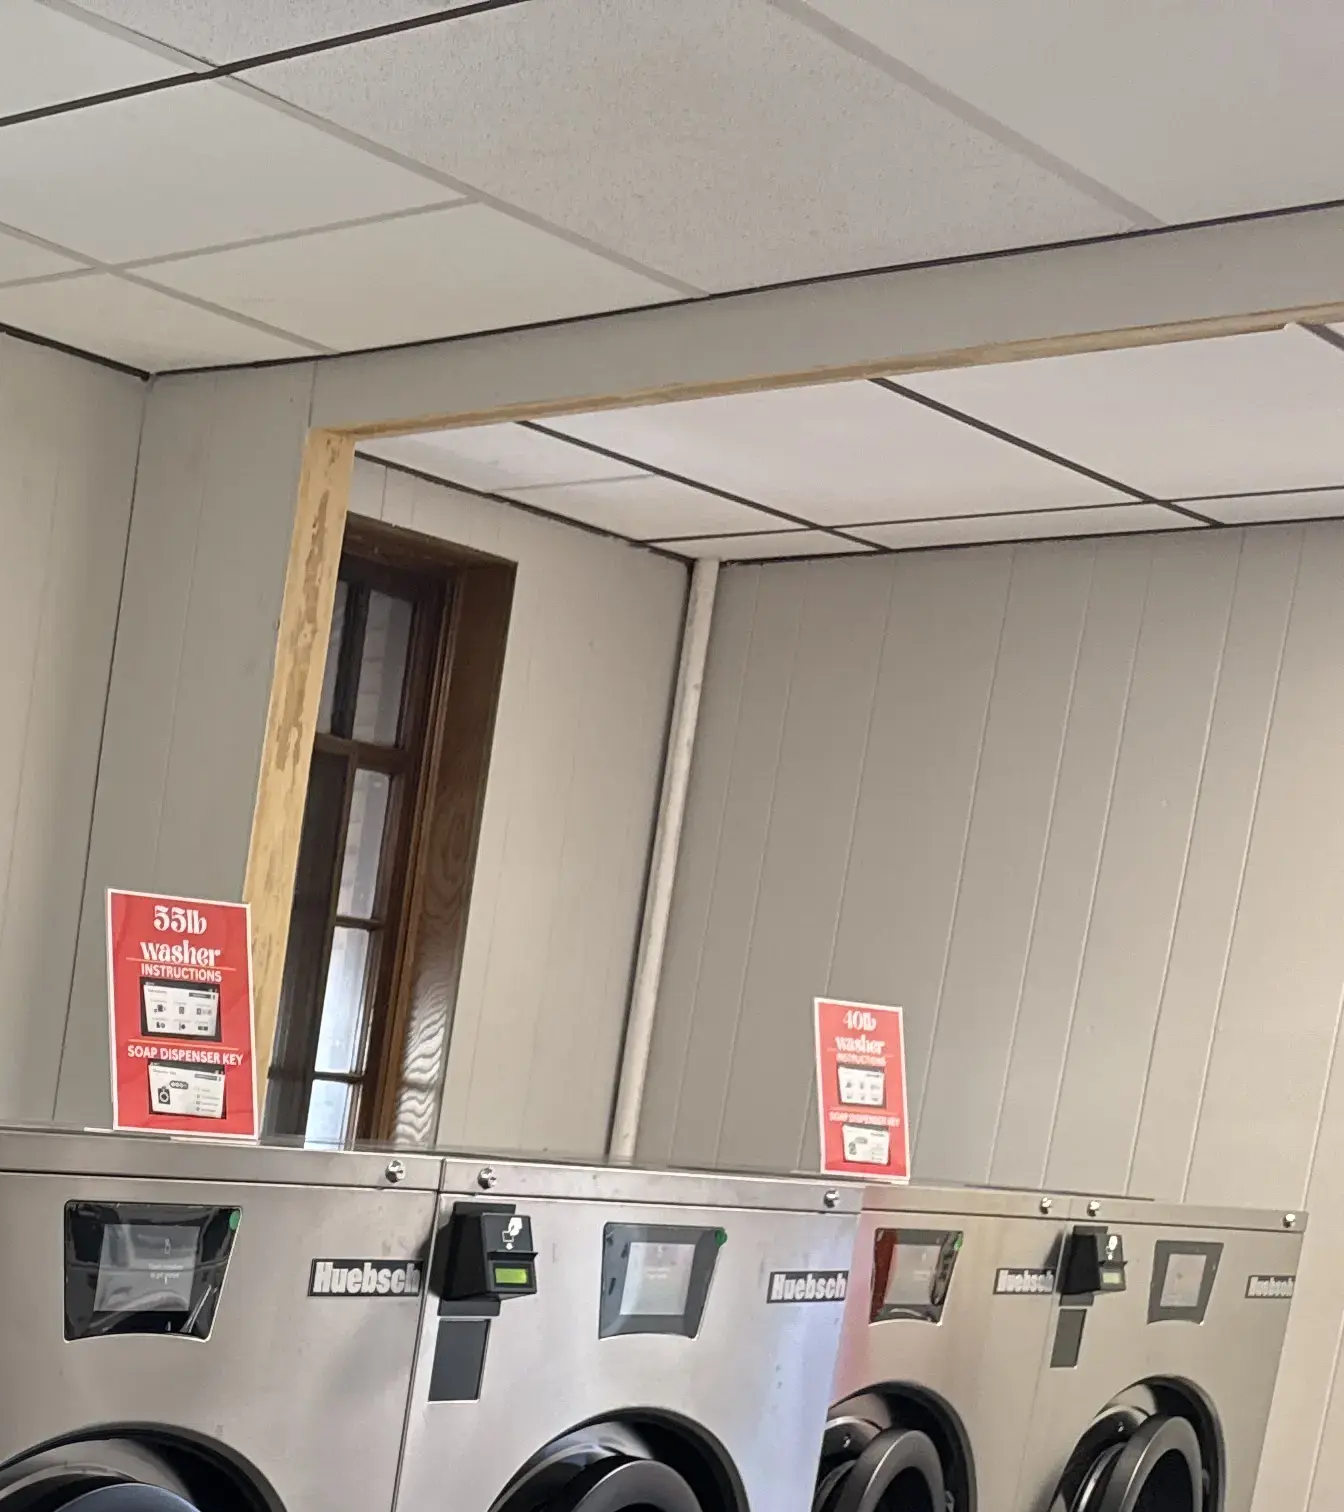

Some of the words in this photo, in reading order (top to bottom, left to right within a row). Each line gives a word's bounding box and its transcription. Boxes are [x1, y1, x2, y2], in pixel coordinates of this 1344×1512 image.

[153, 905, 207, 935] 55lb
[140, 940, 221, 966] washer
[141, 963, 222, 982] INSTRUCTIONS
[127, 1045, 157, 1058] SOAP
[160, 1047, 221, 1065] DISPENSER
[223, 1053, 243, 1066] KEY
[313, 1262, 421, 1294] Huebsch
[771, 1273, 846, 1300] Huebsch
